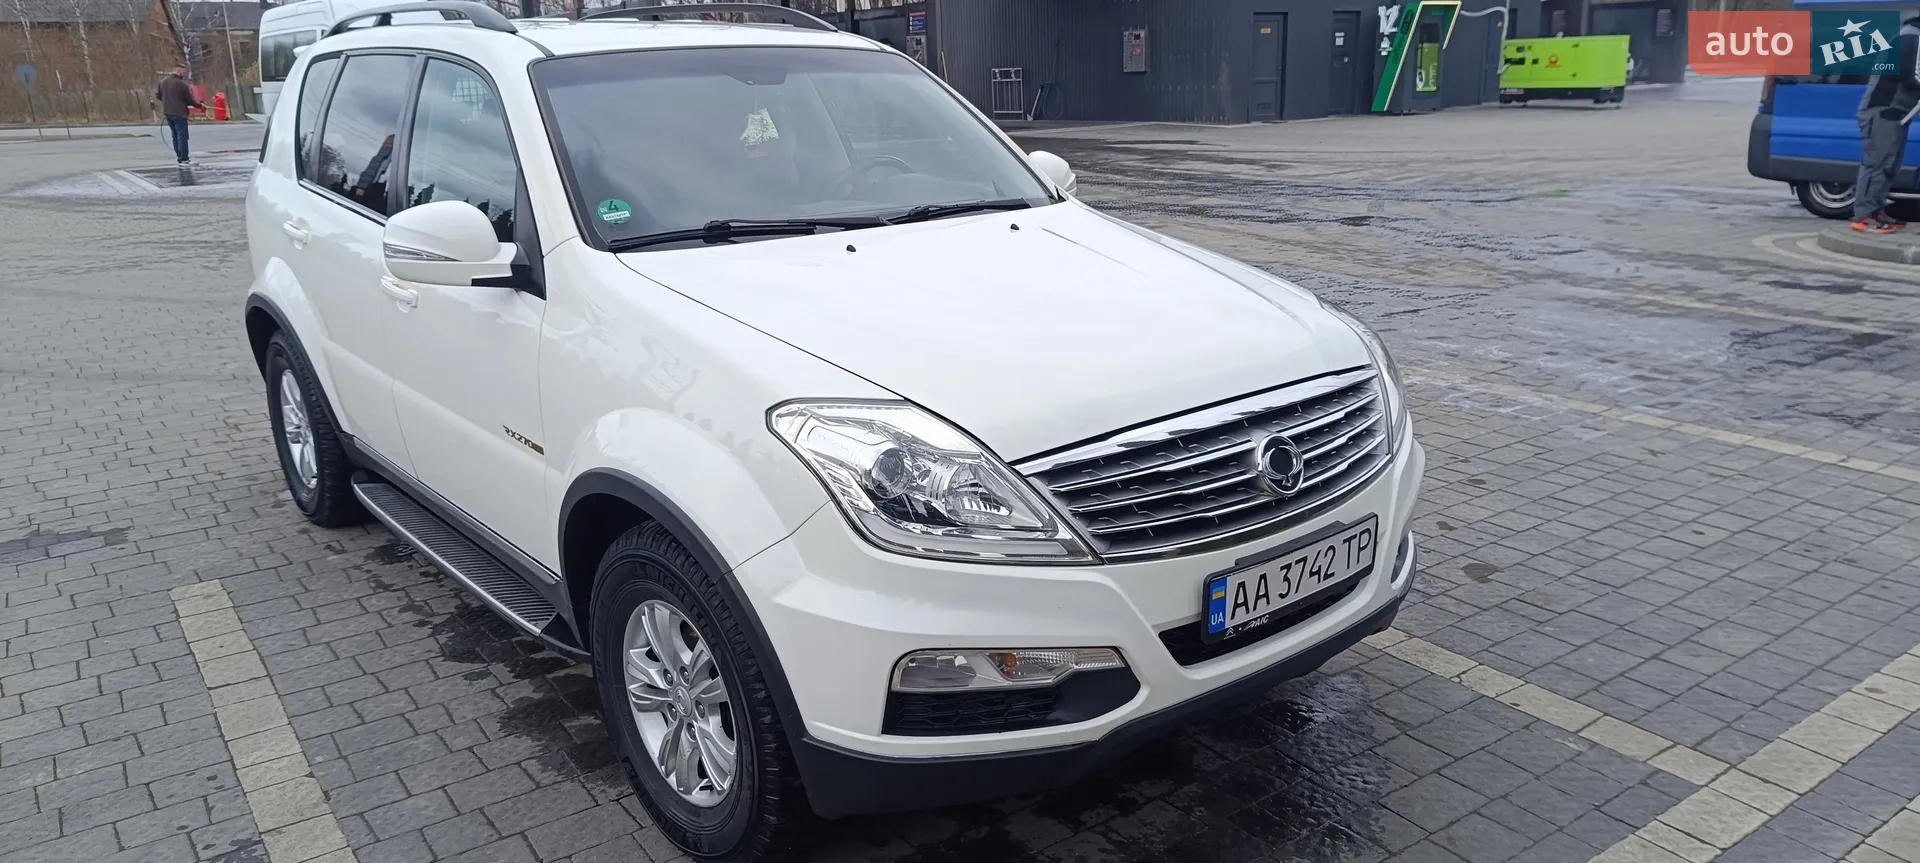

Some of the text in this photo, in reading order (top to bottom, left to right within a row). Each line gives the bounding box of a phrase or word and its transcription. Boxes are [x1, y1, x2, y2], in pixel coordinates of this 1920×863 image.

[1230, 527, 1372, 620] AA 3742 TP
[1211, 612, 1224, 626] UA
